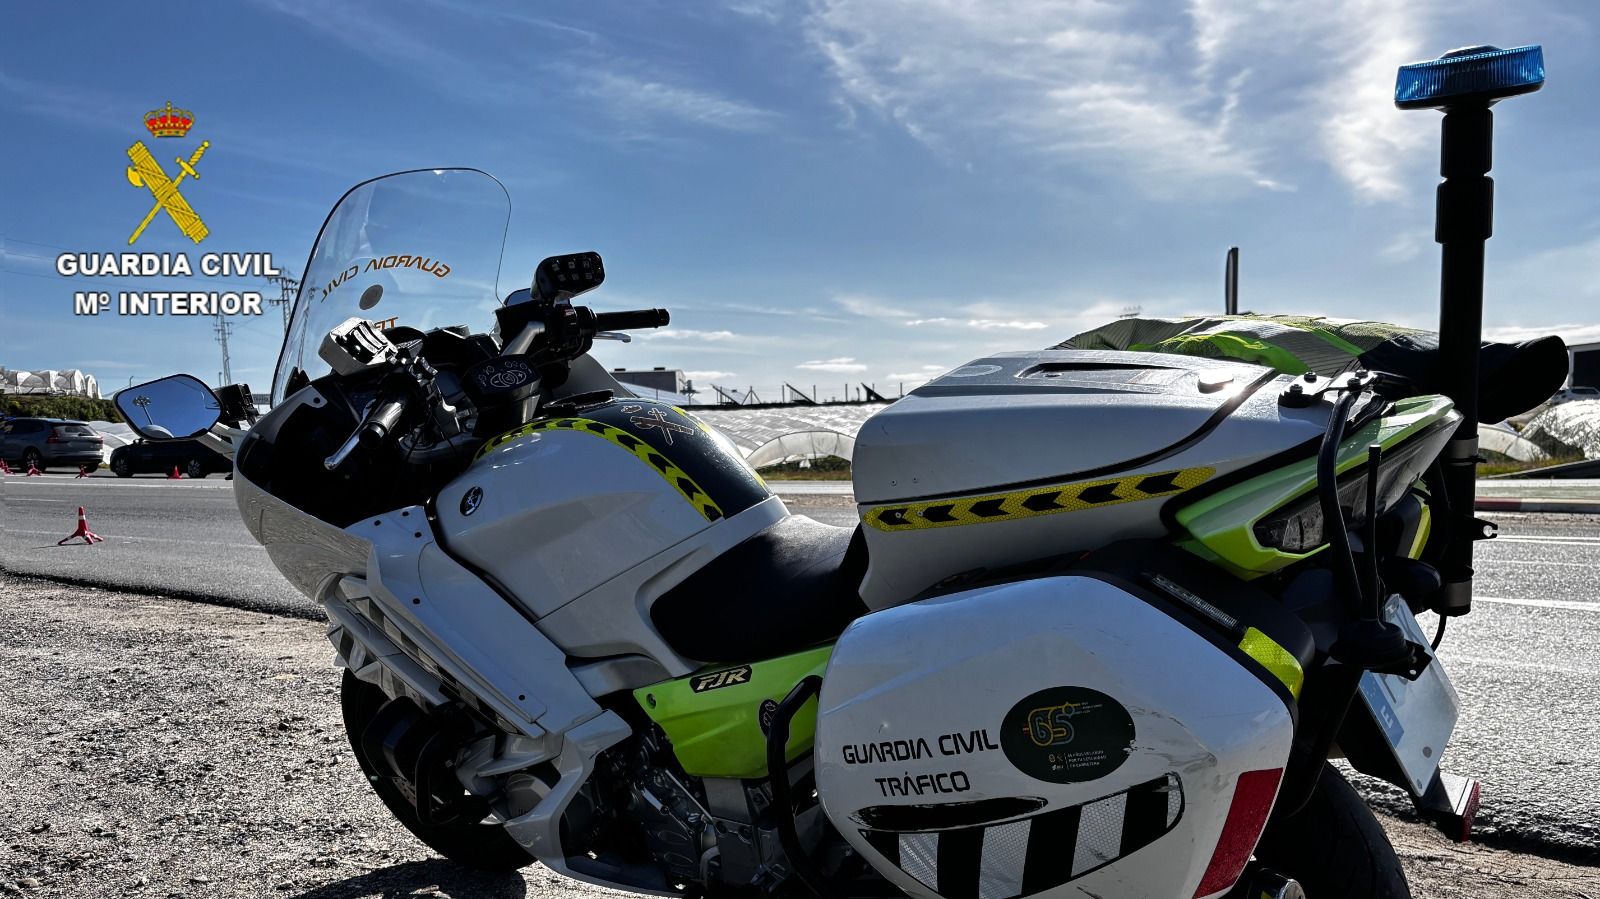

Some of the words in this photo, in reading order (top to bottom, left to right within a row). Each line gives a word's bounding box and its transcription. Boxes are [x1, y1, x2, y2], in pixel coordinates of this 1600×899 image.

[697, 668, 748, 690] FJR
[1027, 703, 1075, 747] 65
[842, 737, 933, 765] GUARDIA
[938, 728, 999, 756] CIVIL
[875, 771, 971, 797] TRÁFICO
